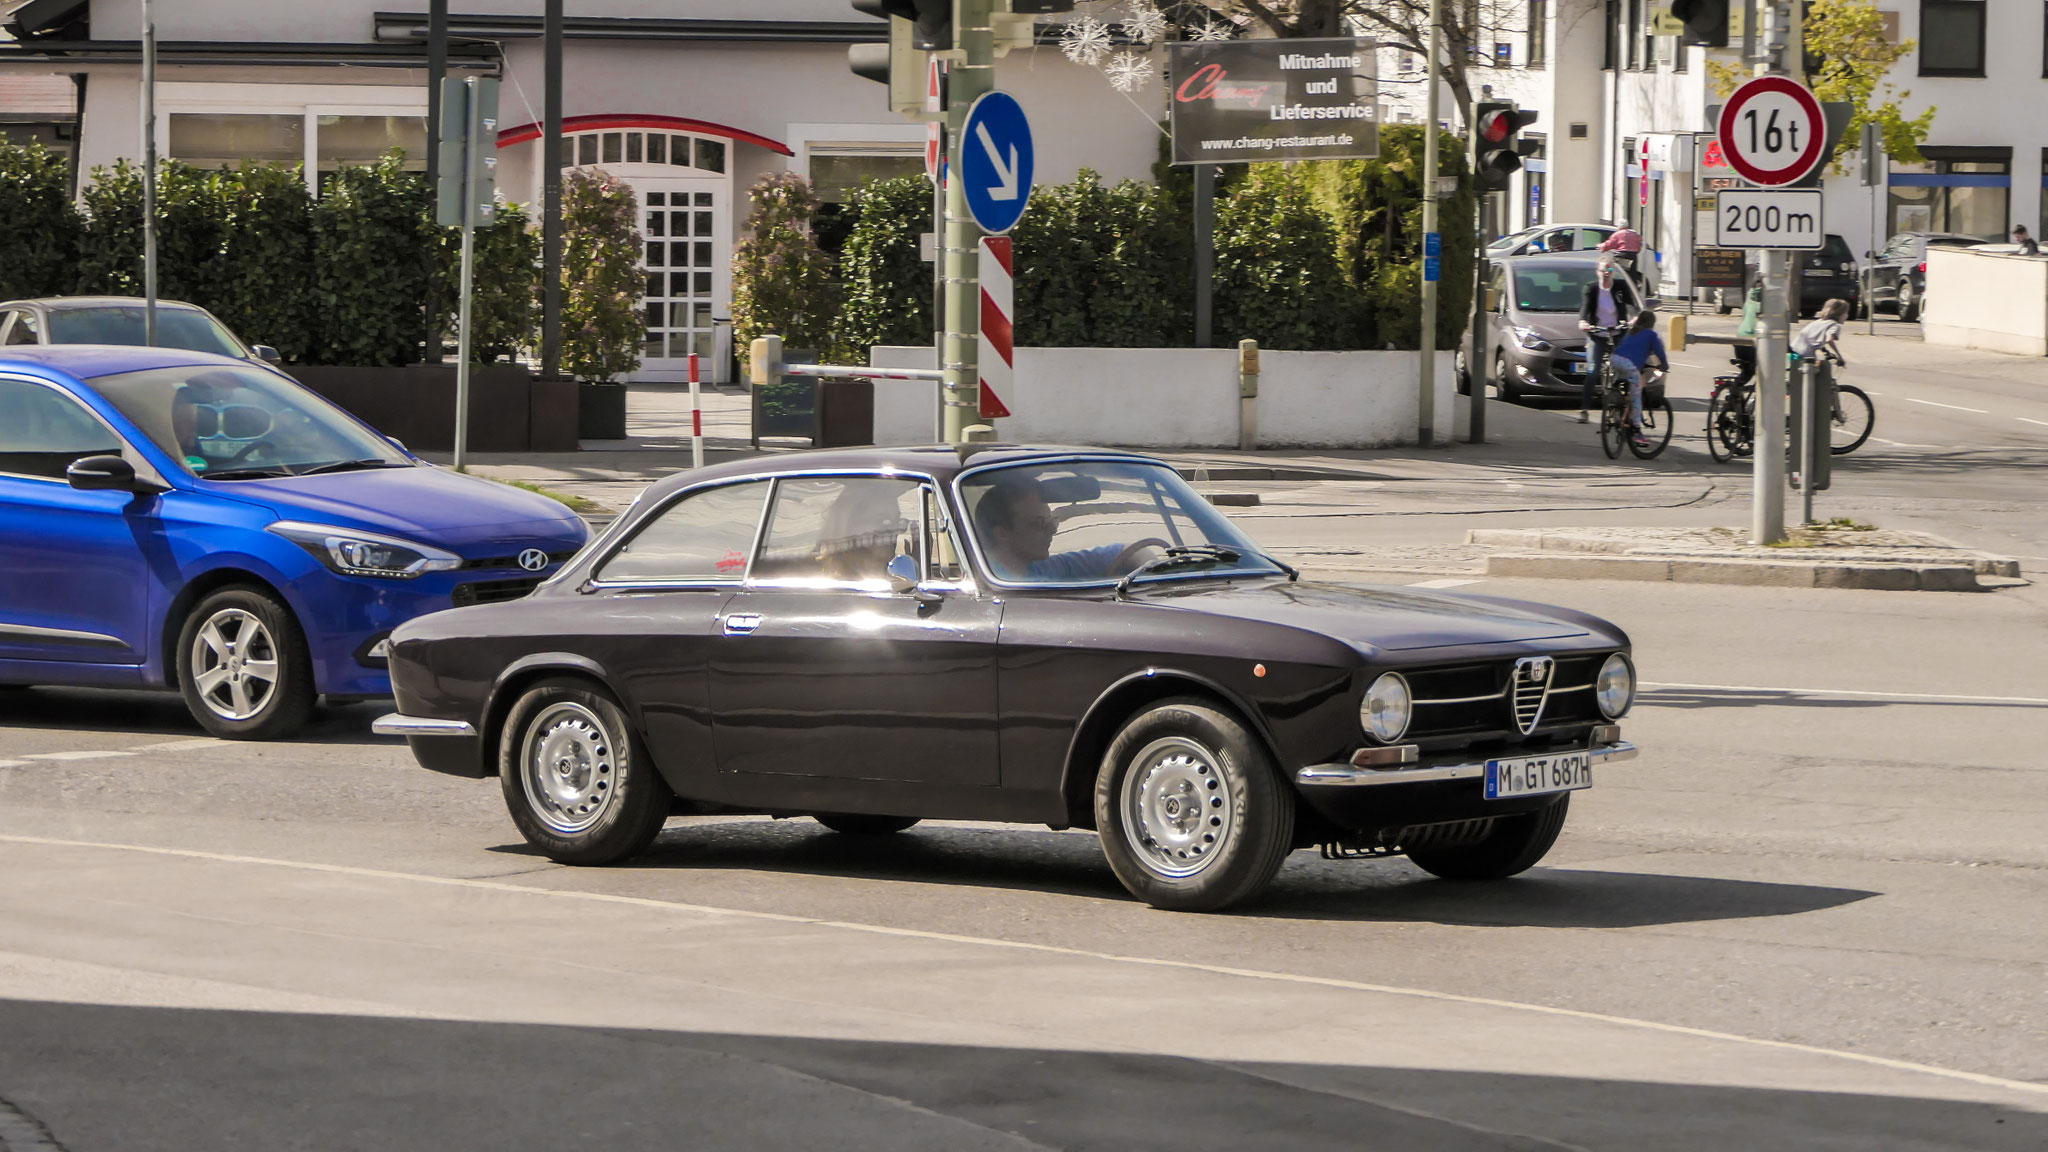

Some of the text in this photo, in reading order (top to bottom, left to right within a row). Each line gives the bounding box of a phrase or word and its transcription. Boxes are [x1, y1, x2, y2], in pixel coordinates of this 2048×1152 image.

[1279, 53, 1361, 70] Mitnahme
[1175, 63, 1270, 107] Chang
[1305, 78, 1338, 94] und
[1270, 102, 1374, 120] Lieferservice
[1201, 133, 1354, 150] www.chang-restaurant.de
[1499, 764, 1512, 792] M
[1525, 760, 1547, 789] GT
[1552, 755, 1590, 786] 687H
